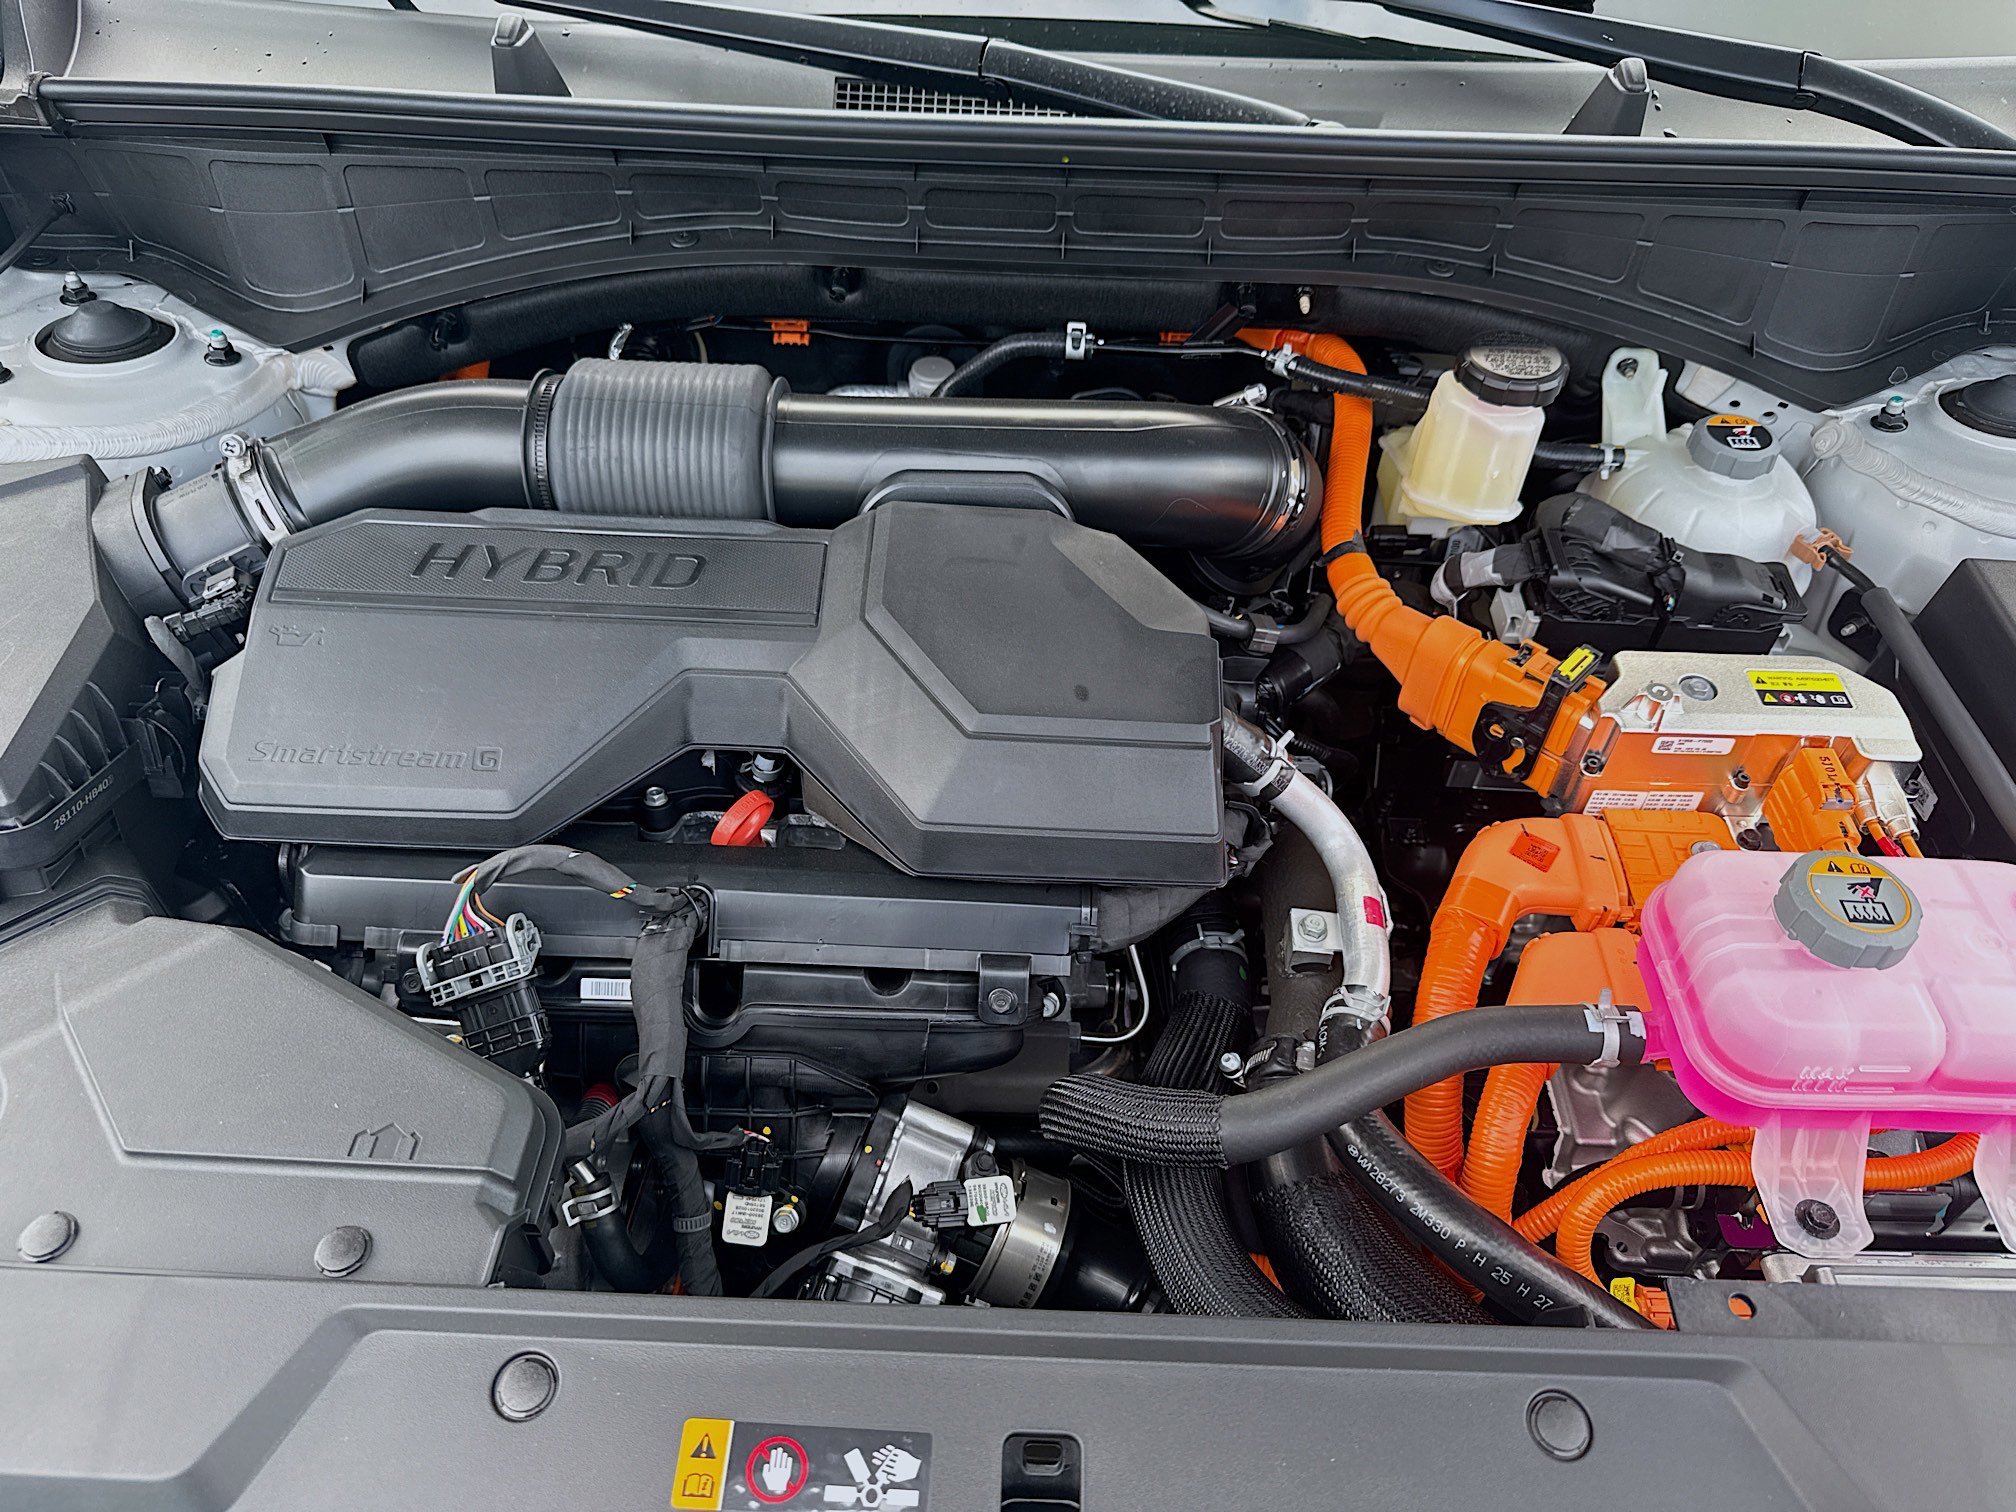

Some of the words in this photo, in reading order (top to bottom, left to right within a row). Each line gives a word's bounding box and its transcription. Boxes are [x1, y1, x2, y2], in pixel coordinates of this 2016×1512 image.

[410, 542, 707, 589] HYBRID
[248, 740, 468, 769] Smartstream
[1409, 1201, 1451, 1240] 2M330
[1491, 1266, 1513, 1285] 25
[1516, 1282, 1531, 1298] H
[1533, 1293, 1555, 1311] 27
